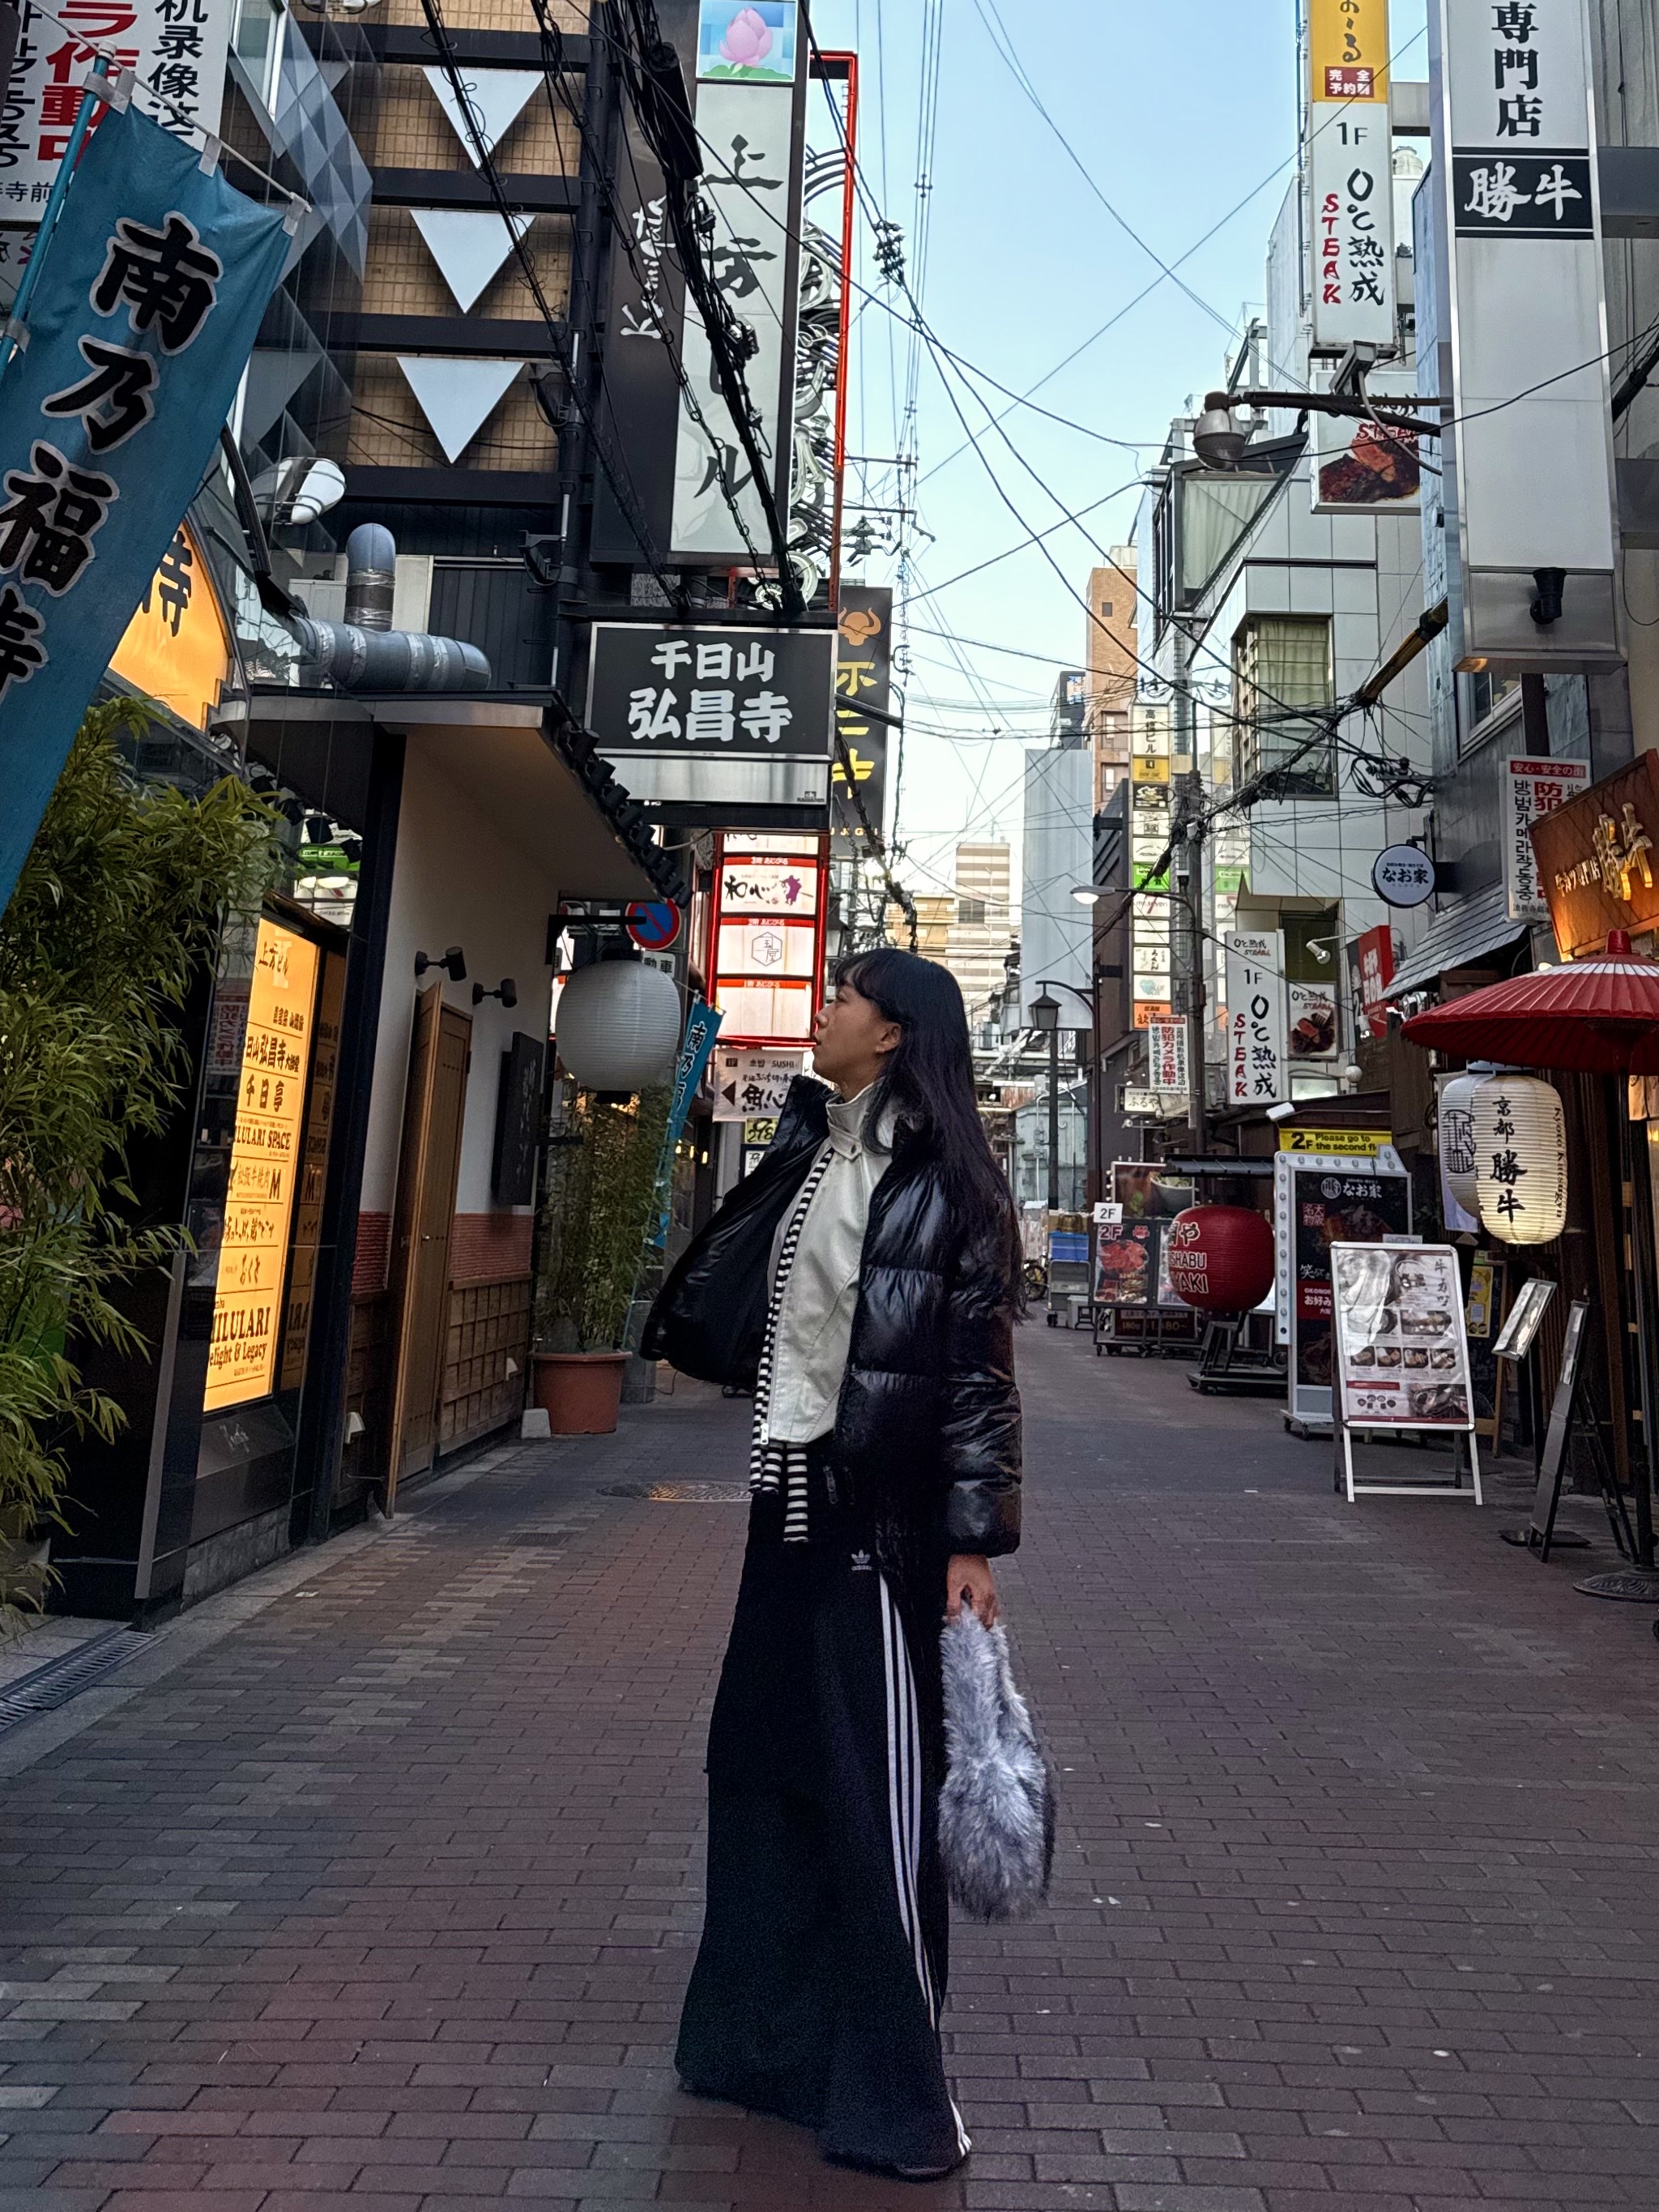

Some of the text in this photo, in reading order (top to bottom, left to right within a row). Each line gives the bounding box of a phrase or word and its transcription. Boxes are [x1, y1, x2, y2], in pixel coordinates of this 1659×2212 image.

[1491, 2, 1543, 137] 専門店
[1328, 83, 1371, 96] 予約制
[1336, 122, 1368, 145] 1F
[1465, 162, 1583, 221] 勝牛
[1321, 193, 1341, 305] STEAK
[650, 640, 774, 682] 千日山
[628, 686, 793, 743] 弘昌寺
[1382, 867, 1429, 884] なお家
[1243, 968, 1263, 984] 1F
[771, 1059, 795, 1068] SUSHI
[1161, 1027, 1176, 1086] 防犯カメラ作動中
[1233, 1013, 1248, 1097] STEAK
[267, 1129, 292, 1151] SPACE
[1291, 1132, 1313, 1150] 2F
[1315, 1134, 1371, 1143] Please go to
[1316, 1142, 1330, 1151] the
[1342, 1182, 1383, 1198] なお家
[1100, 1208, 1117, 1219] 2F
[1099, 1224, 1124, 1241] 2F
[242, 1341, 268, 1364] Legacy
